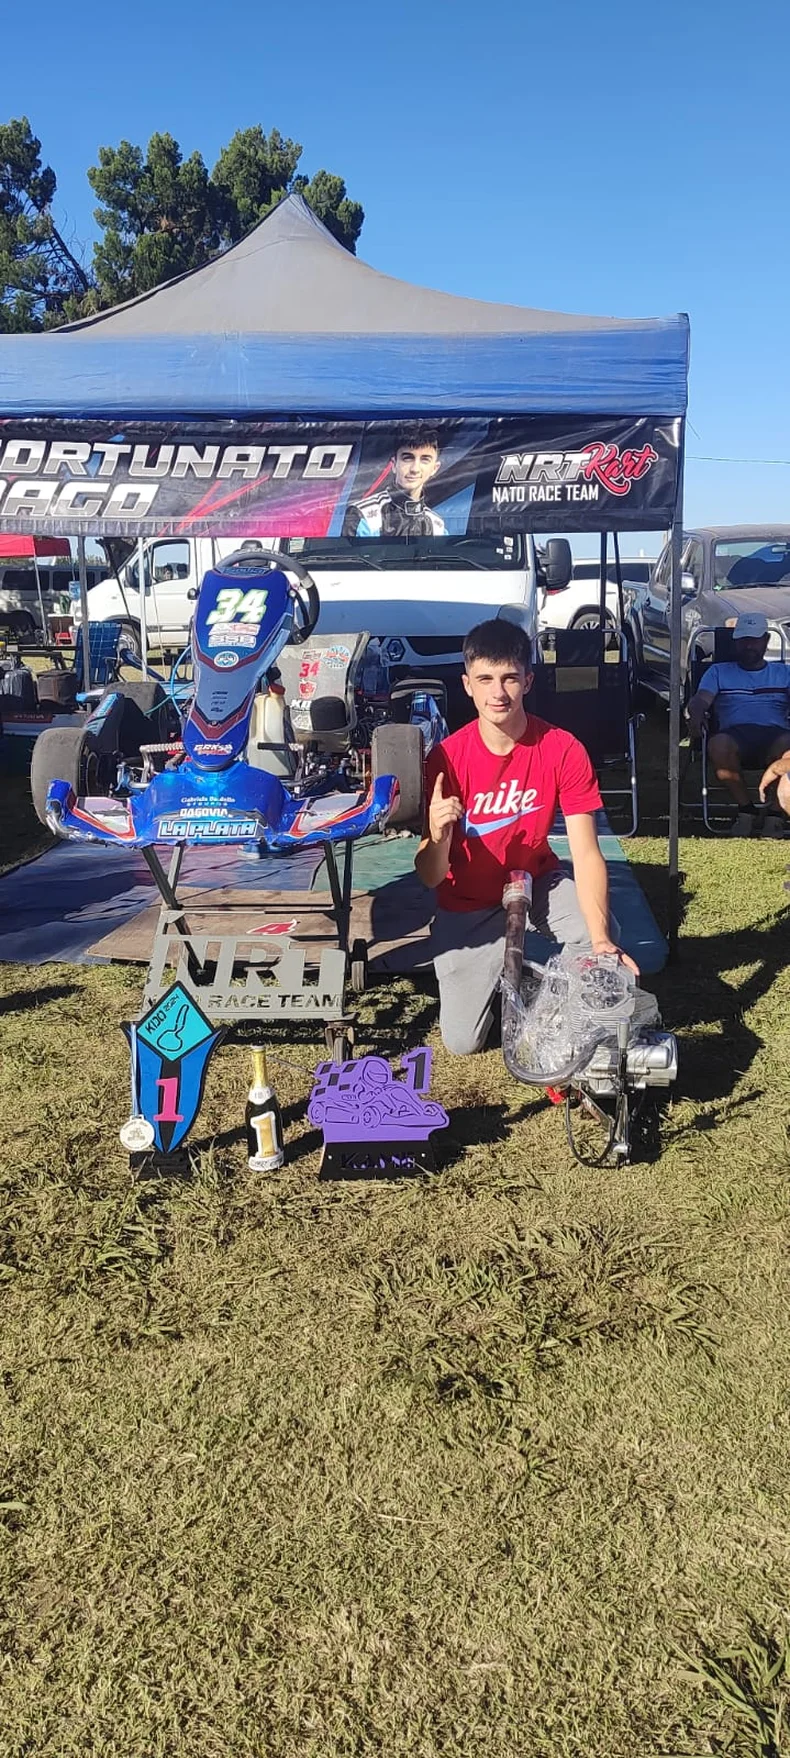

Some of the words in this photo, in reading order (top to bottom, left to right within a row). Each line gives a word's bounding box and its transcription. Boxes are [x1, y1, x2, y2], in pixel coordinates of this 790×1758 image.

[0, 439, 353, 479] ORTUNATO
[494, 450, 591, 484] NRT
[582, 441, 659, 496] Kart
[0, 480, 160, 519] AGO
[491, 485, 527, 503] NATO
[528, 485, 562, 502] RACE
[566, 484, 599, 502] TEAM
[205, 588, 269, 626] 34
[298, 661, 321, 678] 34
[473, 780, 539, 815] nike
[159, 821, 188, 837] LA
[187, 820, 257, 837] PLATA
[159, 940, 341, 988] NRT
[207, 994, 271, 1008] RACE
[277, 994, 342, 1008] TEAM
[407, 1052, 427, 1090] 1
[153, 1077, 184, 1122] 1
[250, 1111, 278, 1158] 1
